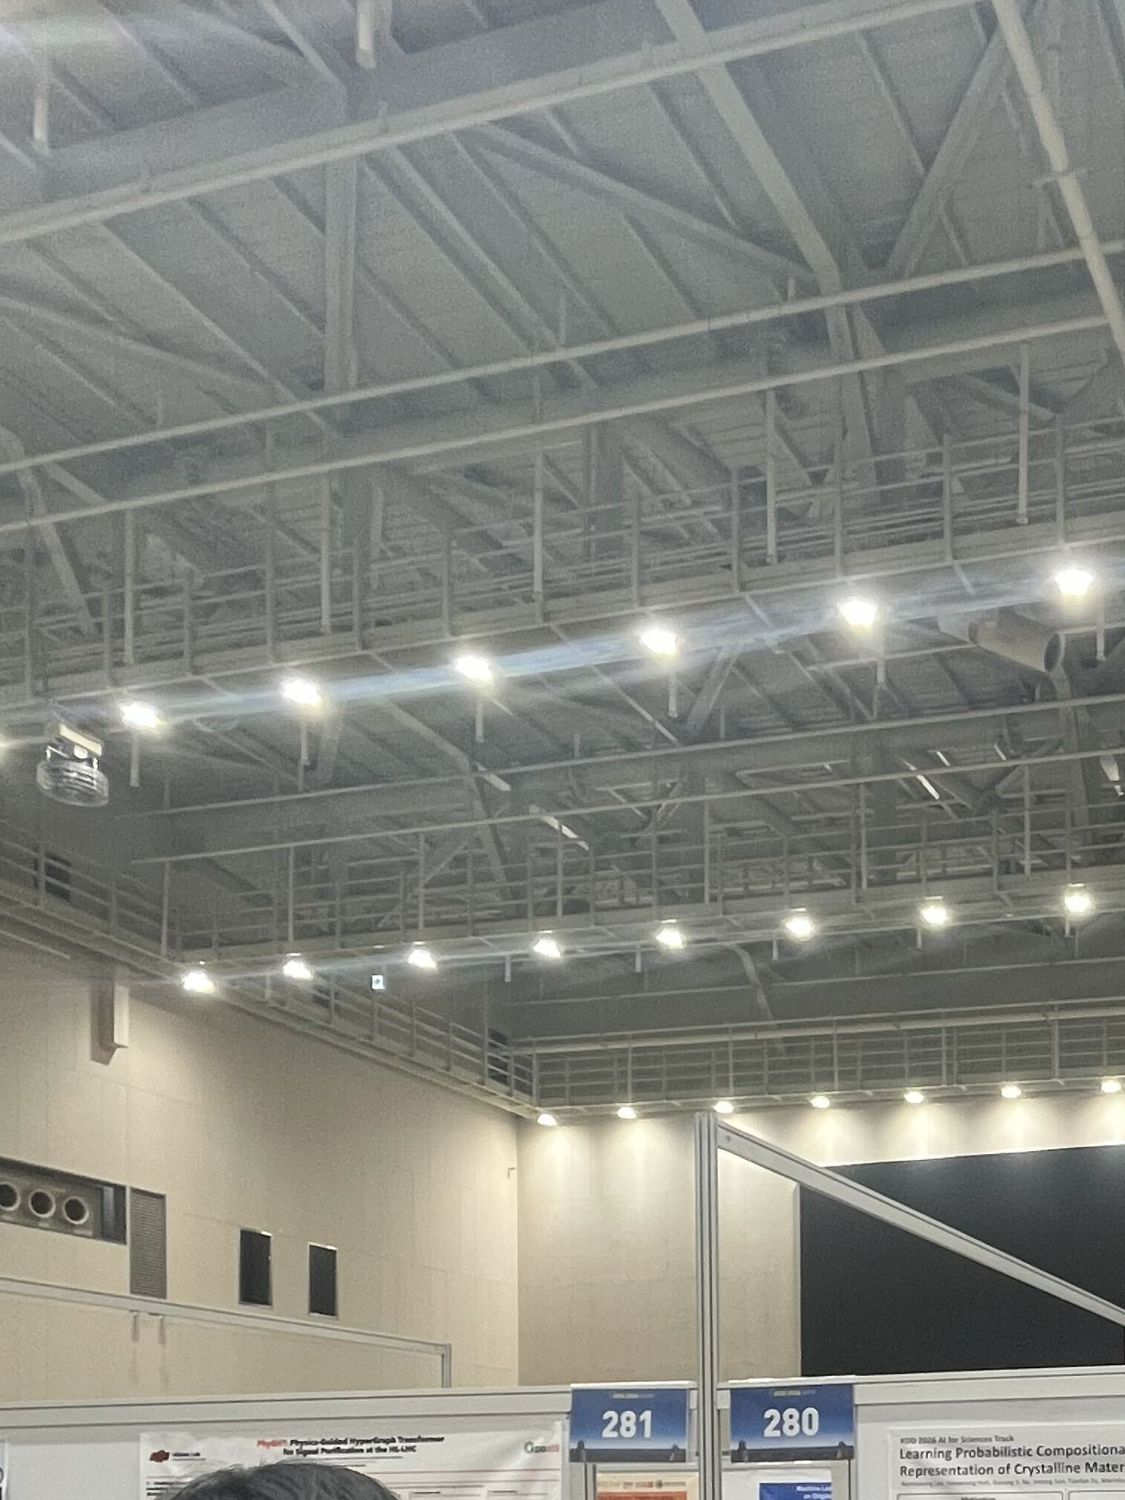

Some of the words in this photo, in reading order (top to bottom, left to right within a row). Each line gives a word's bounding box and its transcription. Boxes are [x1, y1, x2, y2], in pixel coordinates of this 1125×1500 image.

[602, 1410, 652, 1438] 281
[764, 1407, 819, 1438] 280
[960, 1435, 992, 1443] Sciences
[994, 1434, 1014, 1442] Track
[900, 1447, 952, 1461] Learning
[956, 1445, 1033, 1459] Probabilistic
[900, 1464, 994, 1479] Representation
[998, 1462, 1011, 1475] of
[1014, 1461, 1081, 1477] Crystalline
